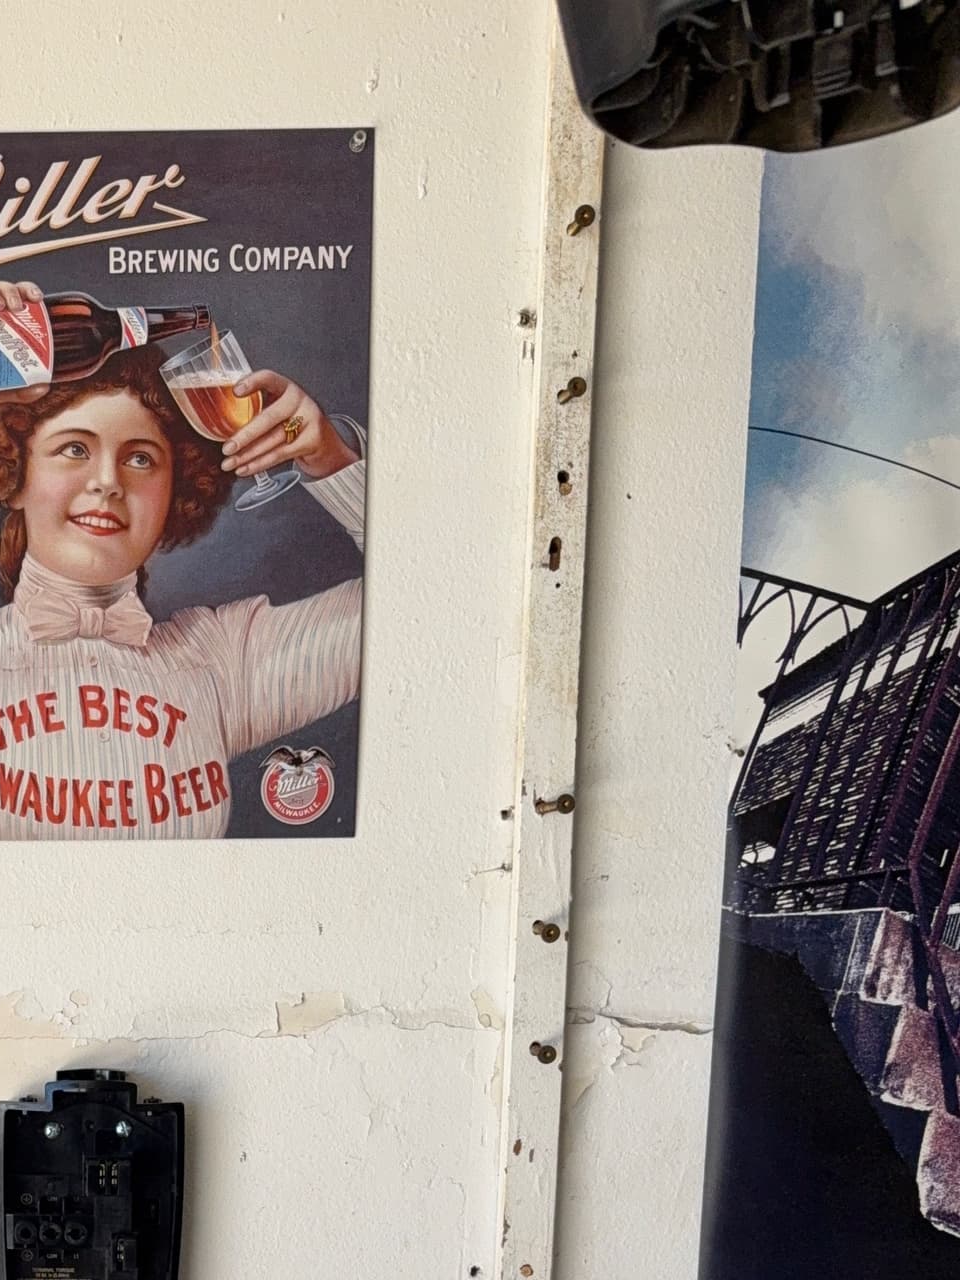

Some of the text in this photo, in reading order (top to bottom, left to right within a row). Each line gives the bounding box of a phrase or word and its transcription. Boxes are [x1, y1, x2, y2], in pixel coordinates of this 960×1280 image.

[109, 244, 354, 274] BREWING COMPANY
[79, 684, 187, 748] BEST
[144, 760, 229, 825] BEER
